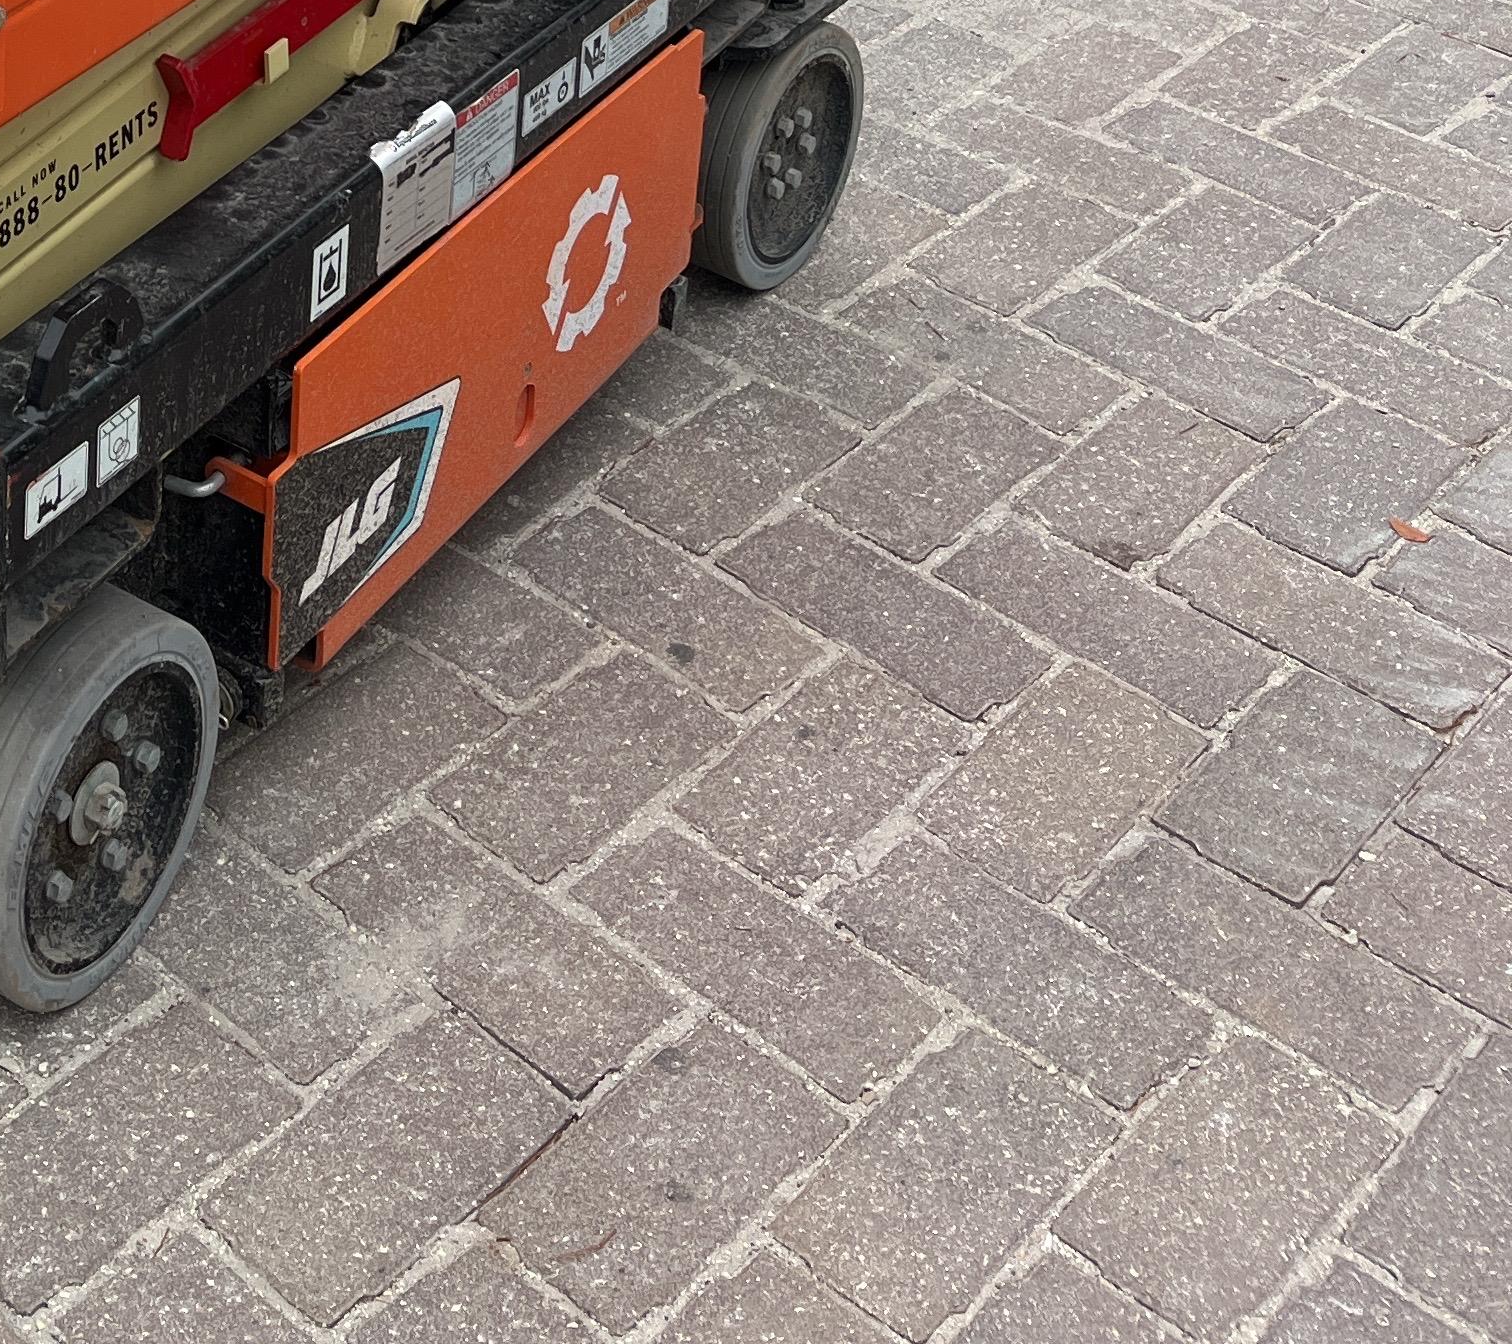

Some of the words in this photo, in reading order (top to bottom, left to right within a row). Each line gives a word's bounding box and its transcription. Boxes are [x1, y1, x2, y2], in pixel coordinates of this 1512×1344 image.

[529, 82, 550, 108] MAX
[31, 158, 57, 188] NOW
[298, 456, 402, 607] JLG
